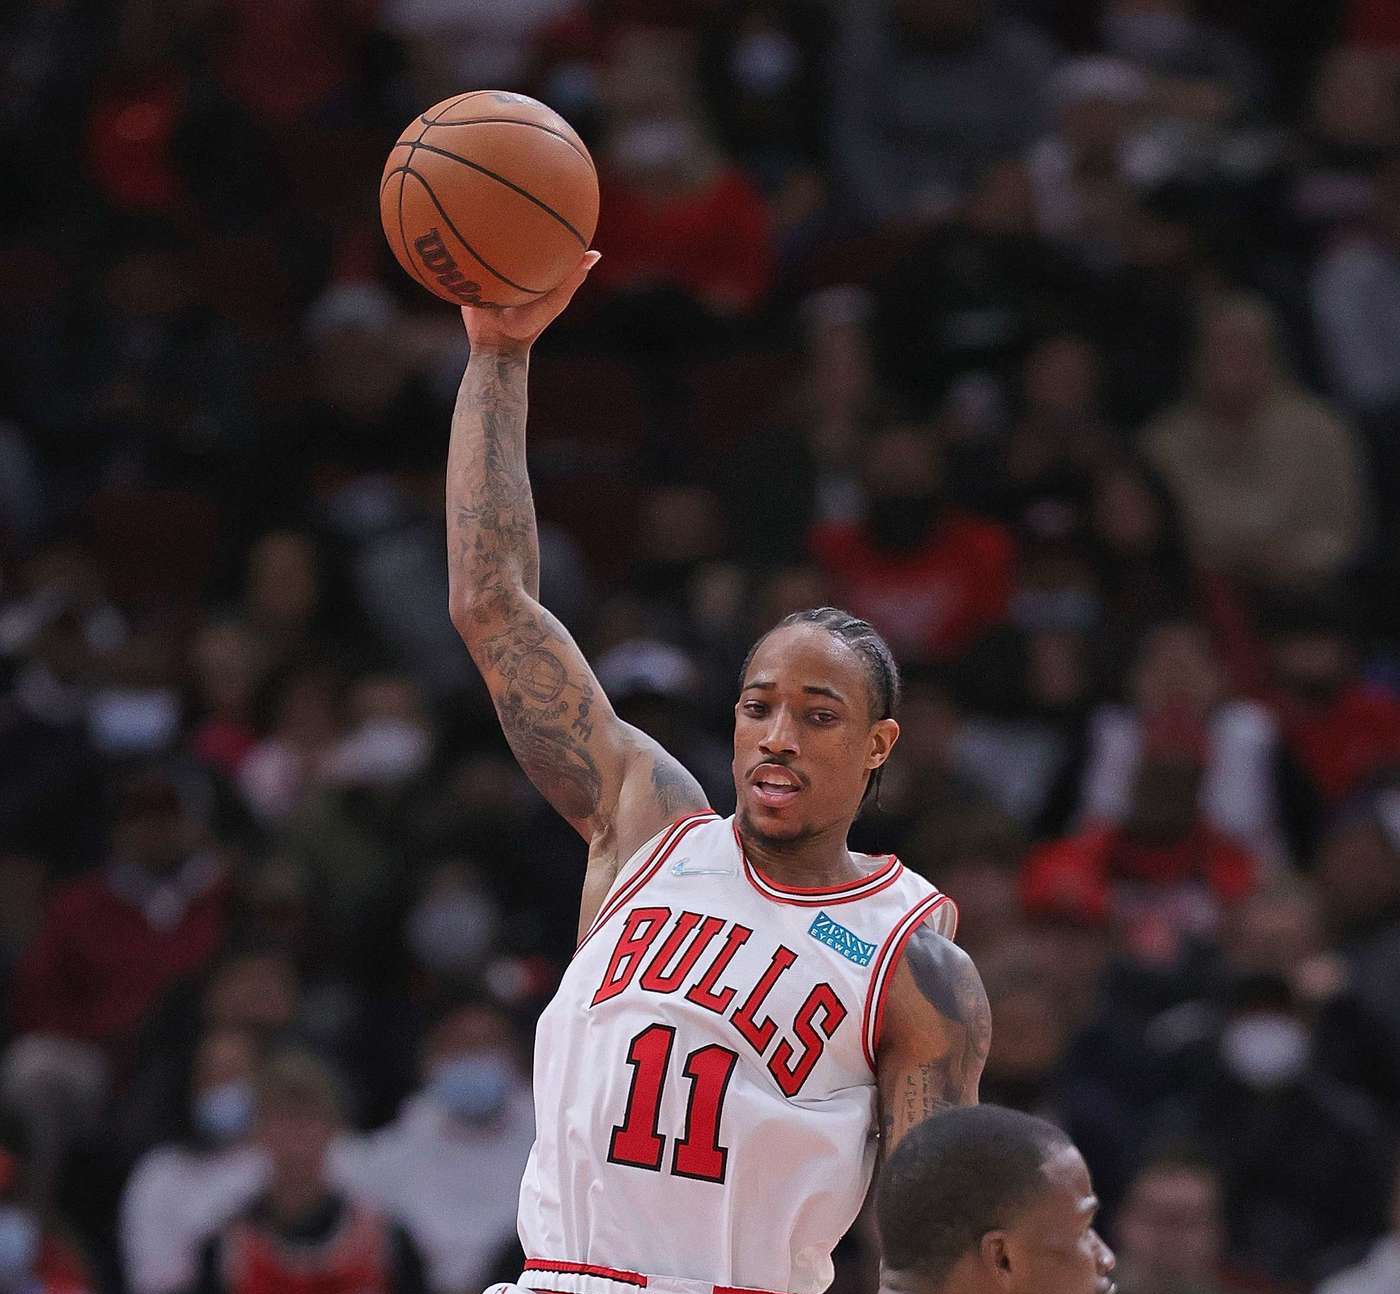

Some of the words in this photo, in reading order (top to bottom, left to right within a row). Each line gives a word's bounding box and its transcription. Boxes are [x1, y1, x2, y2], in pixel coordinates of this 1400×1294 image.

[811, 928, 867, 965] EYEWEAR
[816, 915, 874, 957] ZENNI
[589, 906, 848, 1099] BULLS
[606, 1022, 740, 1185] 11
